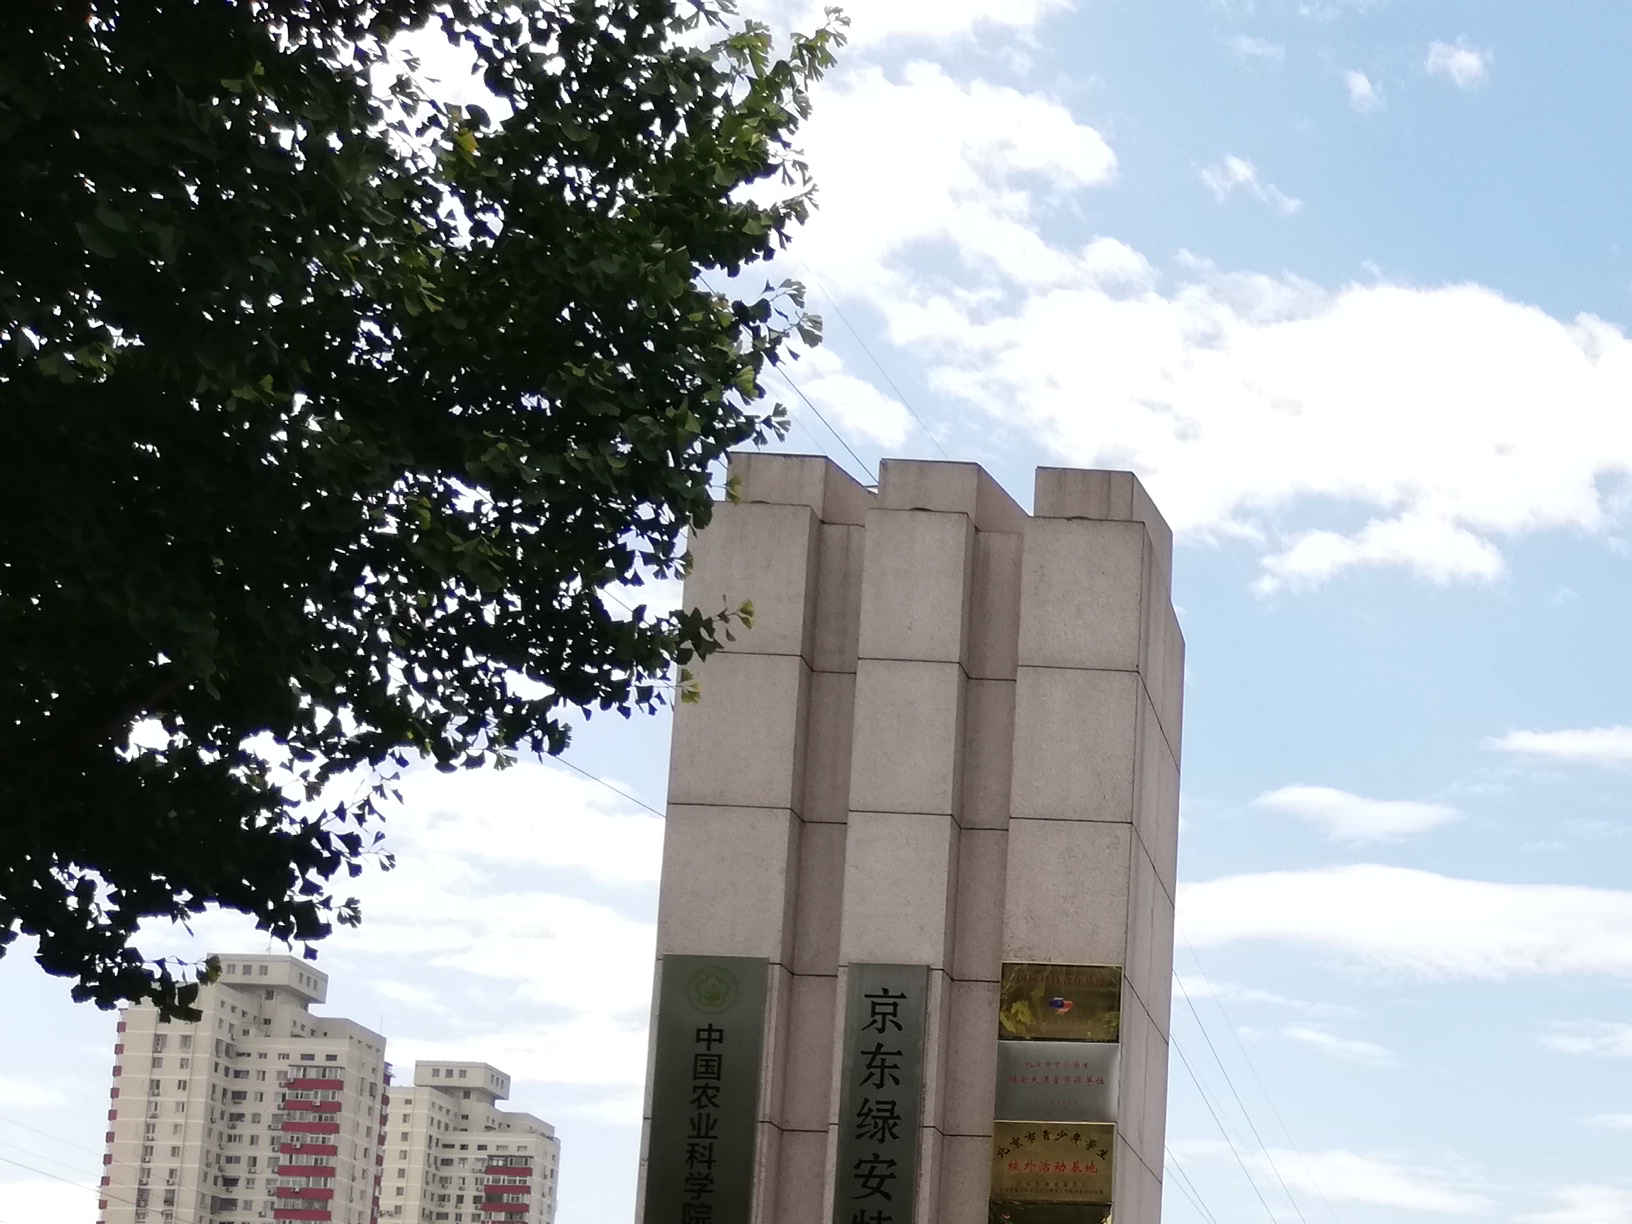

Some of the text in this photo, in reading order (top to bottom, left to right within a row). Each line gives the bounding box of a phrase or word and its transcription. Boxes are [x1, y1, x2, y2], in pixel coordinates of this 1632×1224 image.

[997, 1129, 1109, 1160] 北京市青少年学生
[1007, 1160, 1098, 1173] 校外活动基地
